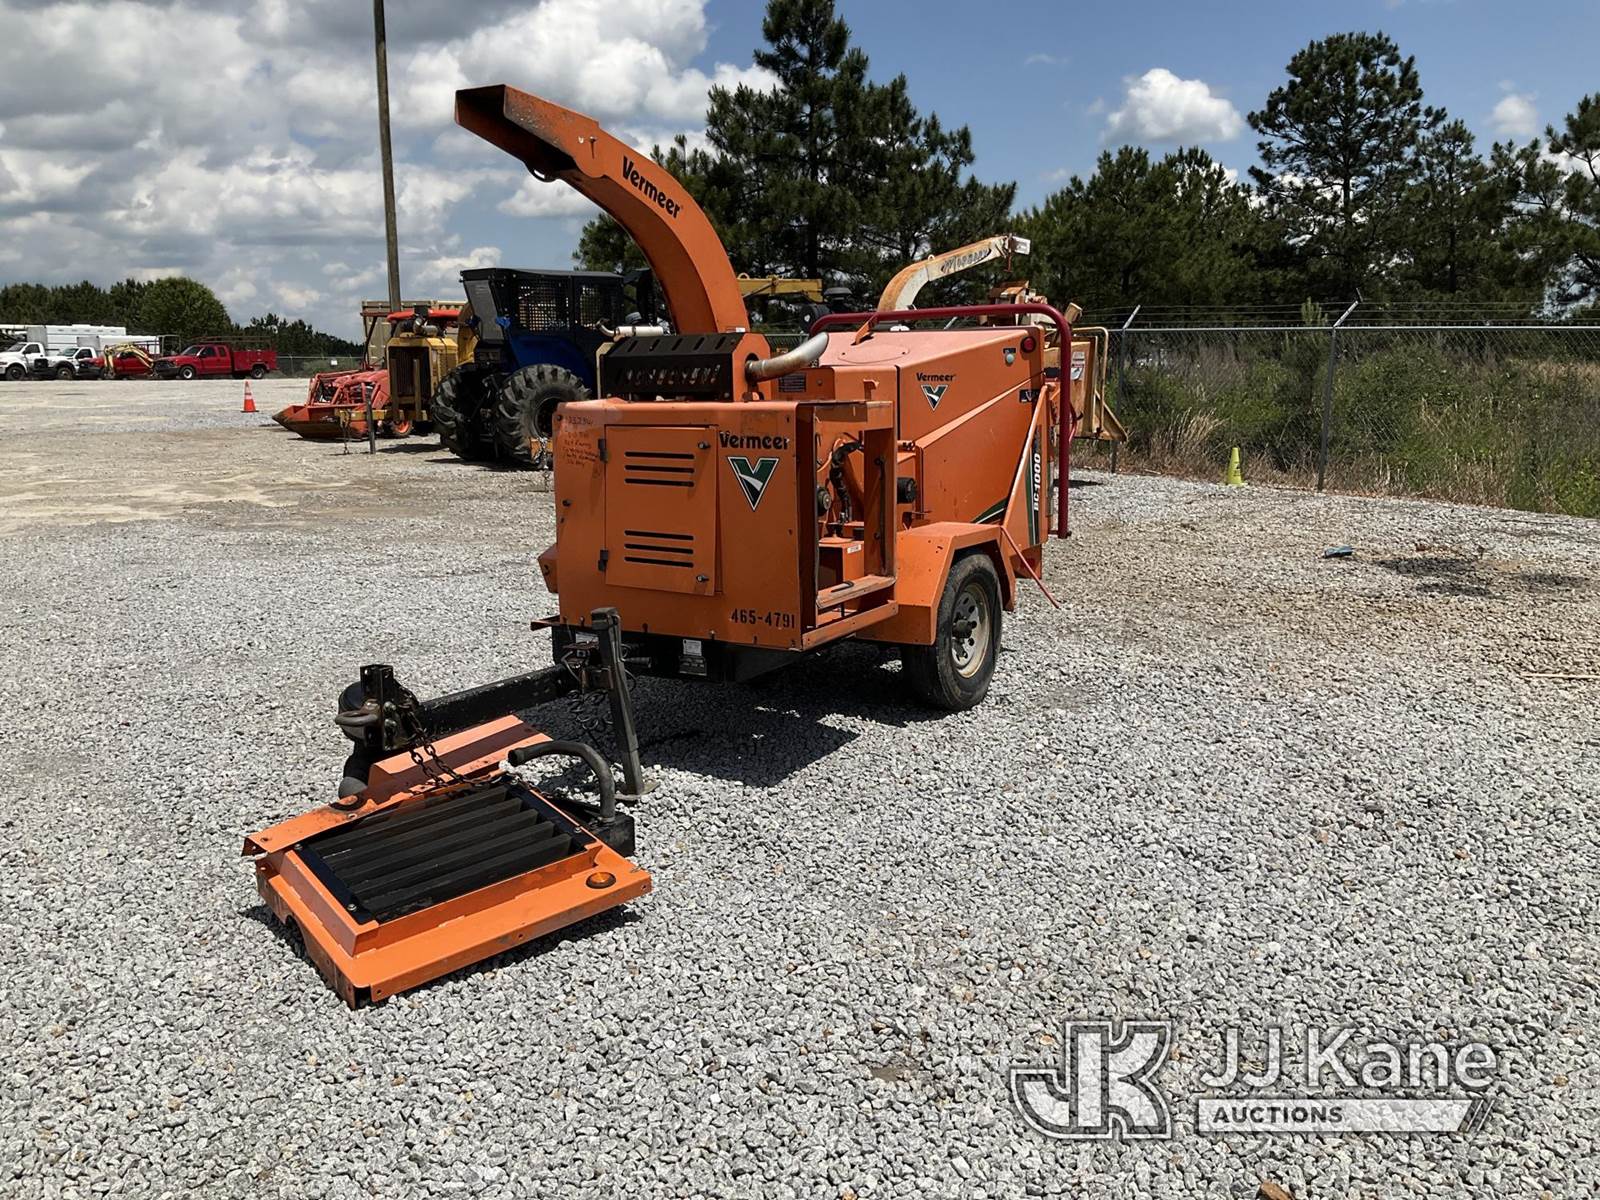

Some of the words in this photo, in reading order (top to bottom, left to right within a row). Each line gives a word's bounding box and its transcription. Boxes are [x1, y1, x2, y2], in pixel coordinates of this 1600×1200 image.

[623, 155, 681, 219] Vermeer
[916, 372, 954, 382] Vermeer
[719, 431, 789, 450] Vermeer
[731, 608, 795, 629] 465-4791
